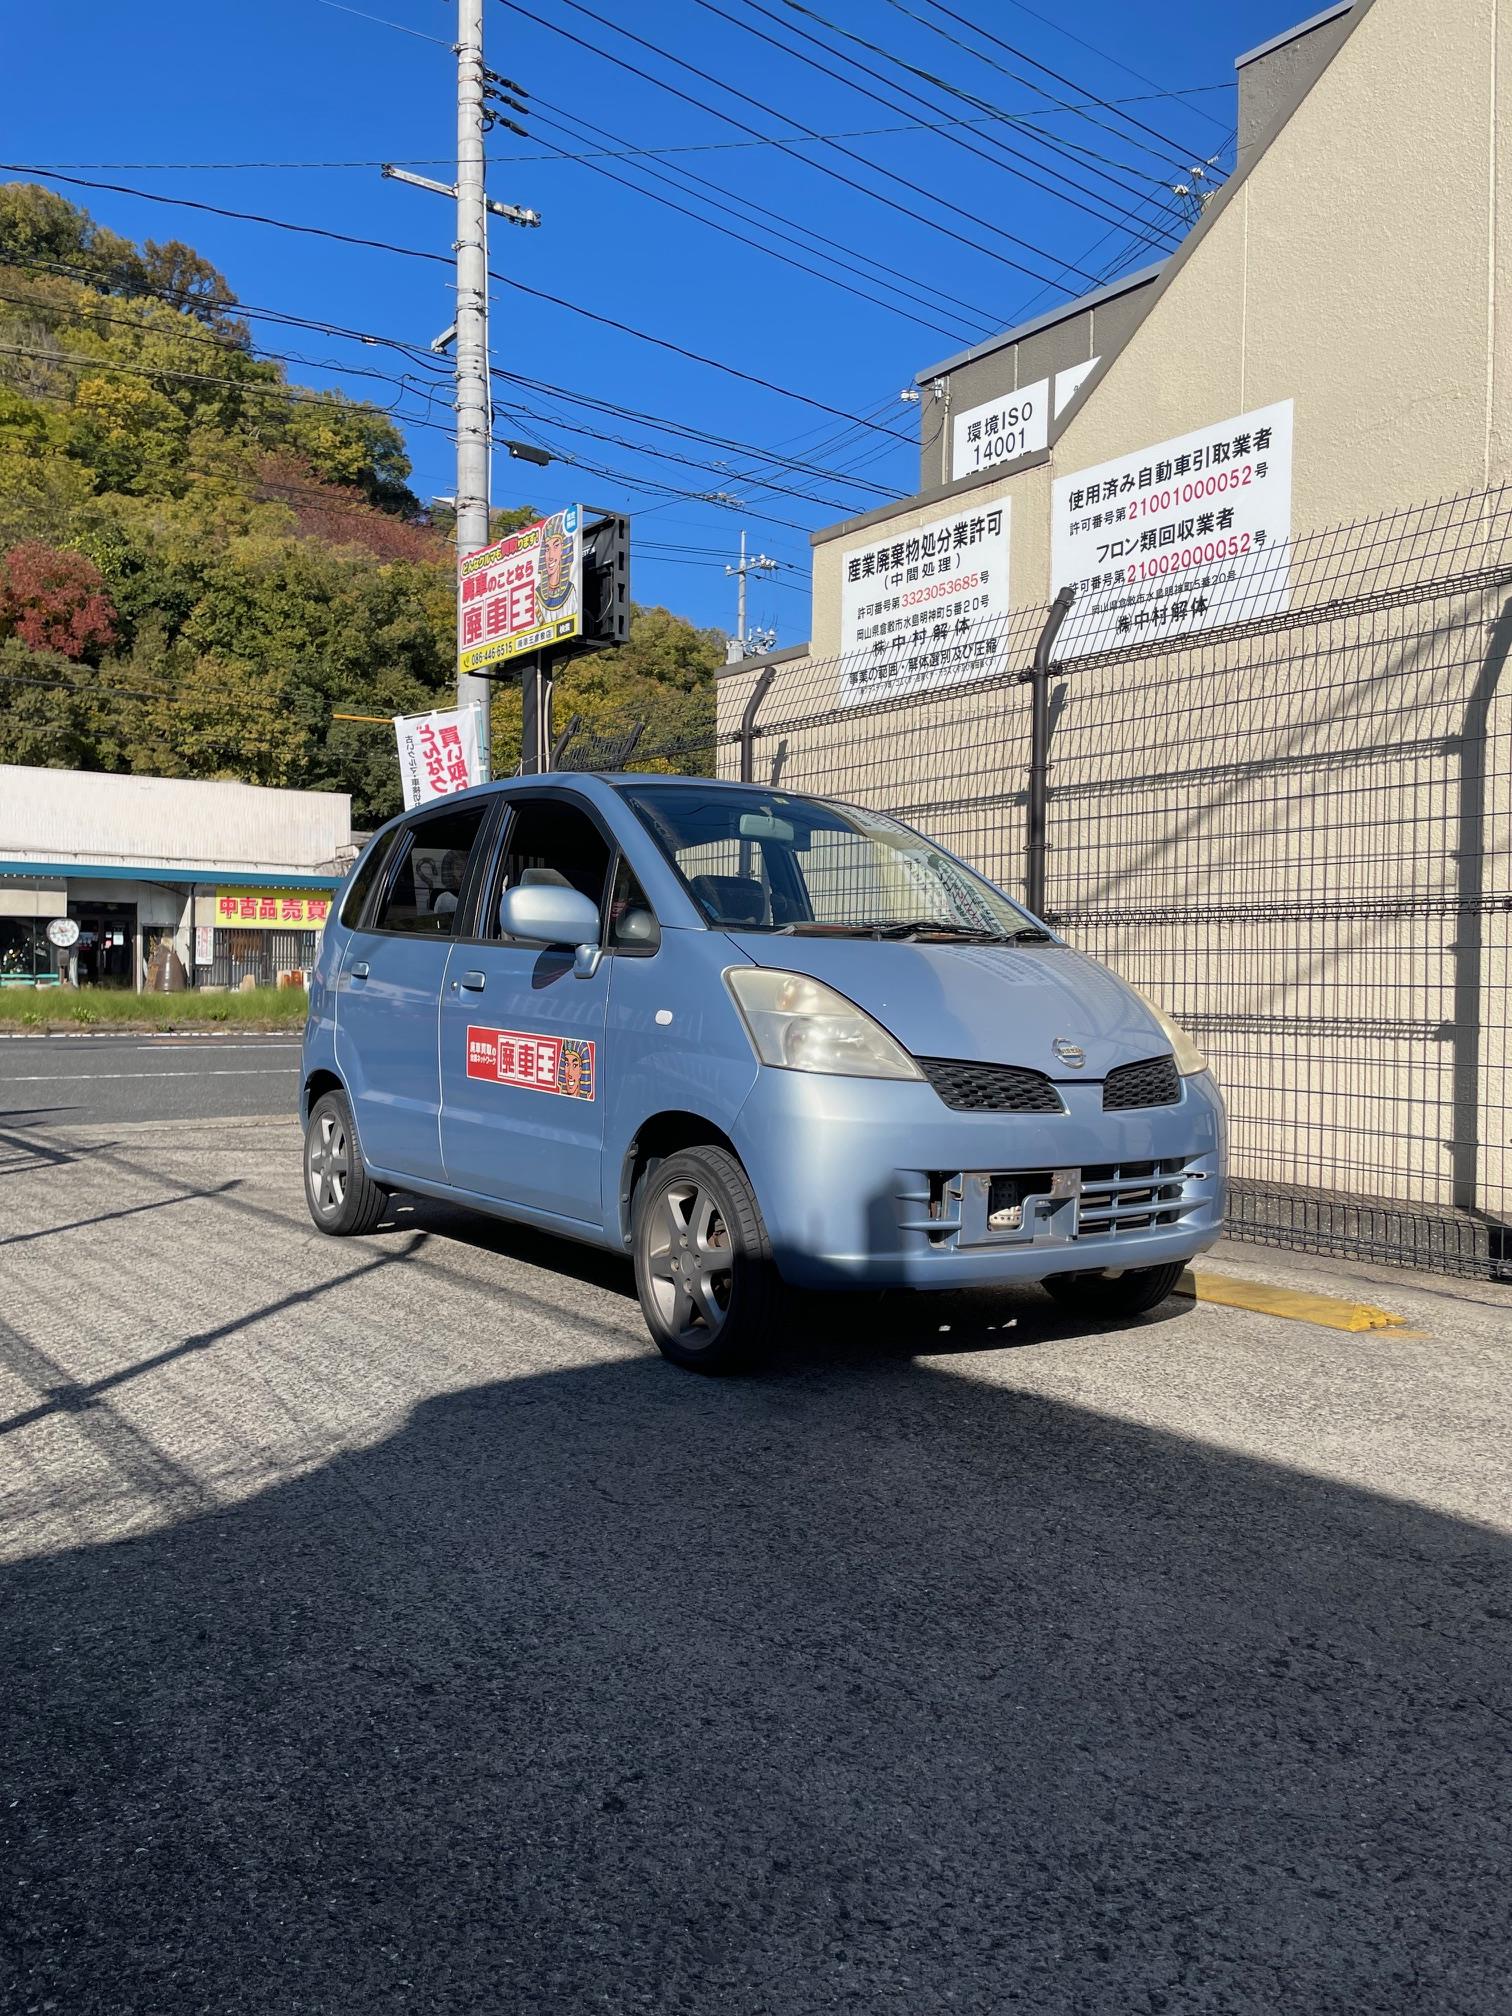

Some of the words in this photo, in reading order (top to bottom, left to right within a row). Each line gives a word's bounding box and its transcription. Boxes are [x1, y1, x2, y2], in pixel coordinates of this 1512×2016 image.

[967, 402, 1033, 443] 環境ISO
[974, 427, 1025, 465] 14001
[1069, 427, 1273, 512] 使用済み自動車引取業者
[848, 510, 1003, 583] 産業廃棄物処分業許可
[1096, 507, 1235, 563] フロン類回収業者
[463, 580, 535, 646] 廃車王
[471, 641, 513, 666] 086-446-6515
[220, 896, 328, 920] 中古品売買
[499, 1038, 556, 1084] 廃車王
